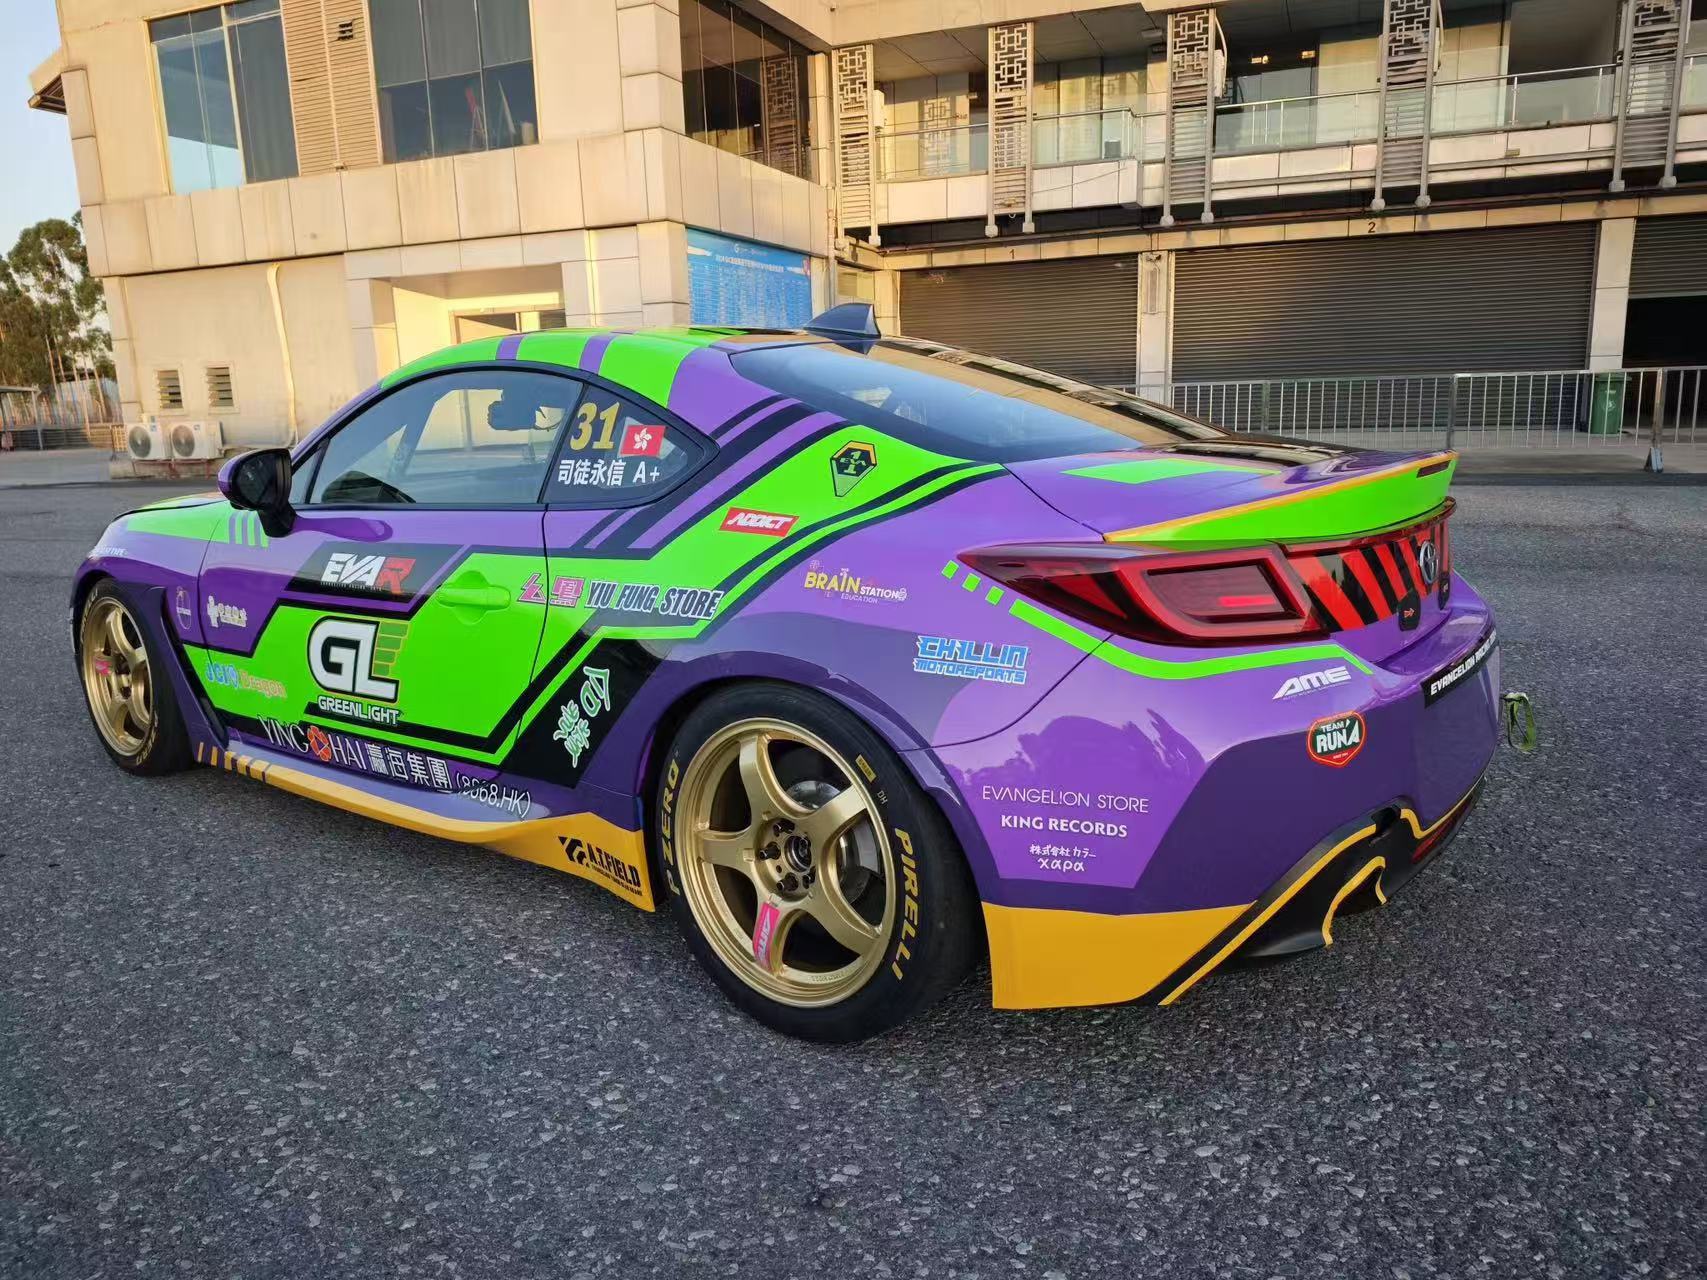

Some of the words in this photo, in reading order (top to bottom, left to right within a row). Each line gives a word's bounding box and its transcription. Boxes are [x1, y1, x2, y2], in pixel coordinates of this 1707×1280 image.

[1367, 221, 1376, 233] 2
[570, 401, 620, 451] 31
[558, 459, 626, 486] 司徒永信
[632, 461, 660, 484] A+
[585, 580, 619, 609] YIU
[614, 583, 660, 613] FUNG
[657, 587, 725, 620] STORE
[804, 568, 862, 593] BRAIN
[860, 586, 899, 600] STATION
[307, 616, 400, 703] GL
[916, 635, 1029, 669] CHILLIN
[912, 657, 1027, 685] MOTORSPORTS
[1272, 666, 1352, 700] AME
[1430, 655, 1476, 696] EVANGELION
[317, 695, 402, 725] GREENLIGHT
[1320, 720, 1345, 733] TEAM
[257, 715, 309, 753] YING
[328, 733, 367, 770] HAI
[661, 758, 680, 867] ZERO
[1097, 794, 1149, 813] STORE
[1001, 815, 1044, 830] KING
[1048, 818, 1128, 838] RECORDS
[892, 827, 919, 981] PIRELLI
